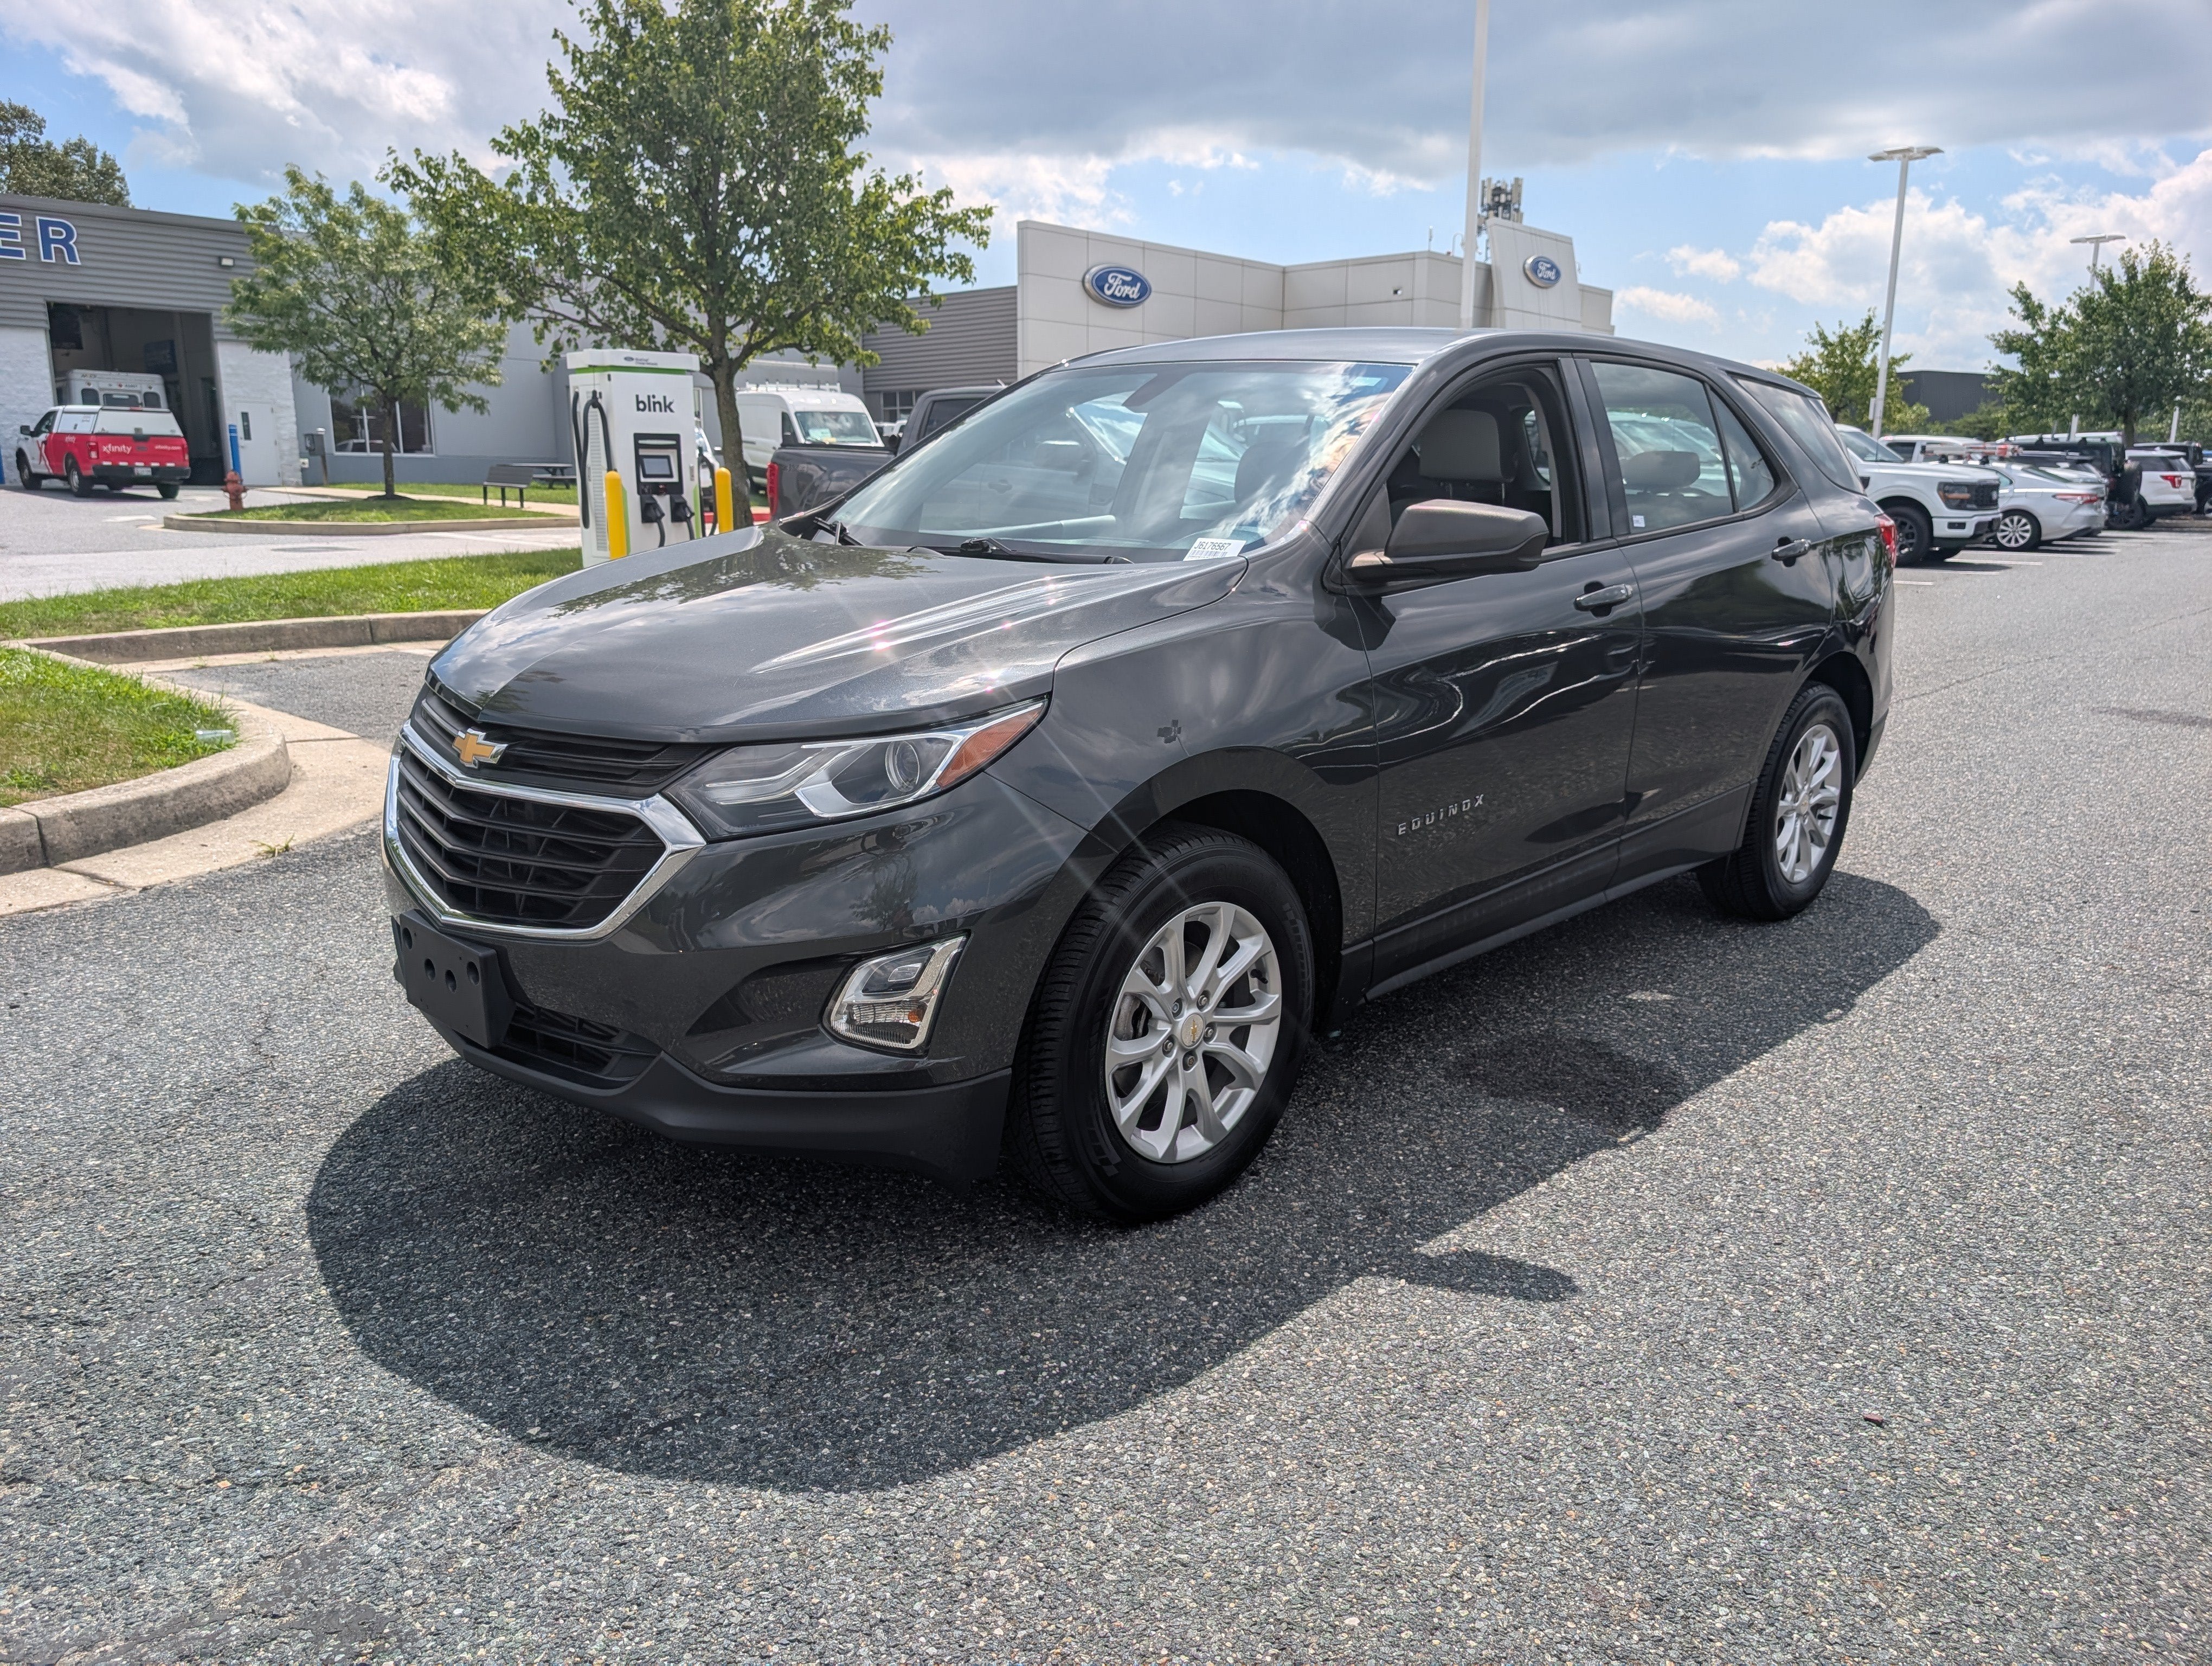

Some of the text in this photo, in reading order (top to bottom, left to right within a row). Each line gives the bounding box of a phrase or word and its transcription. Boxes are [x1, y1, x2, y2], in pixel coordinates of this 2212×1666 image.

[1537, 261, 1557, 280] Ford
[1103, 273, 1141, 299] Ford
[635, 394, 675, 413] blink
[102, 443, 132, 454] xfinity
[1194, 541, 1232, 551] J6176567
[1398, 793, 1484, 836] EQUINOX
